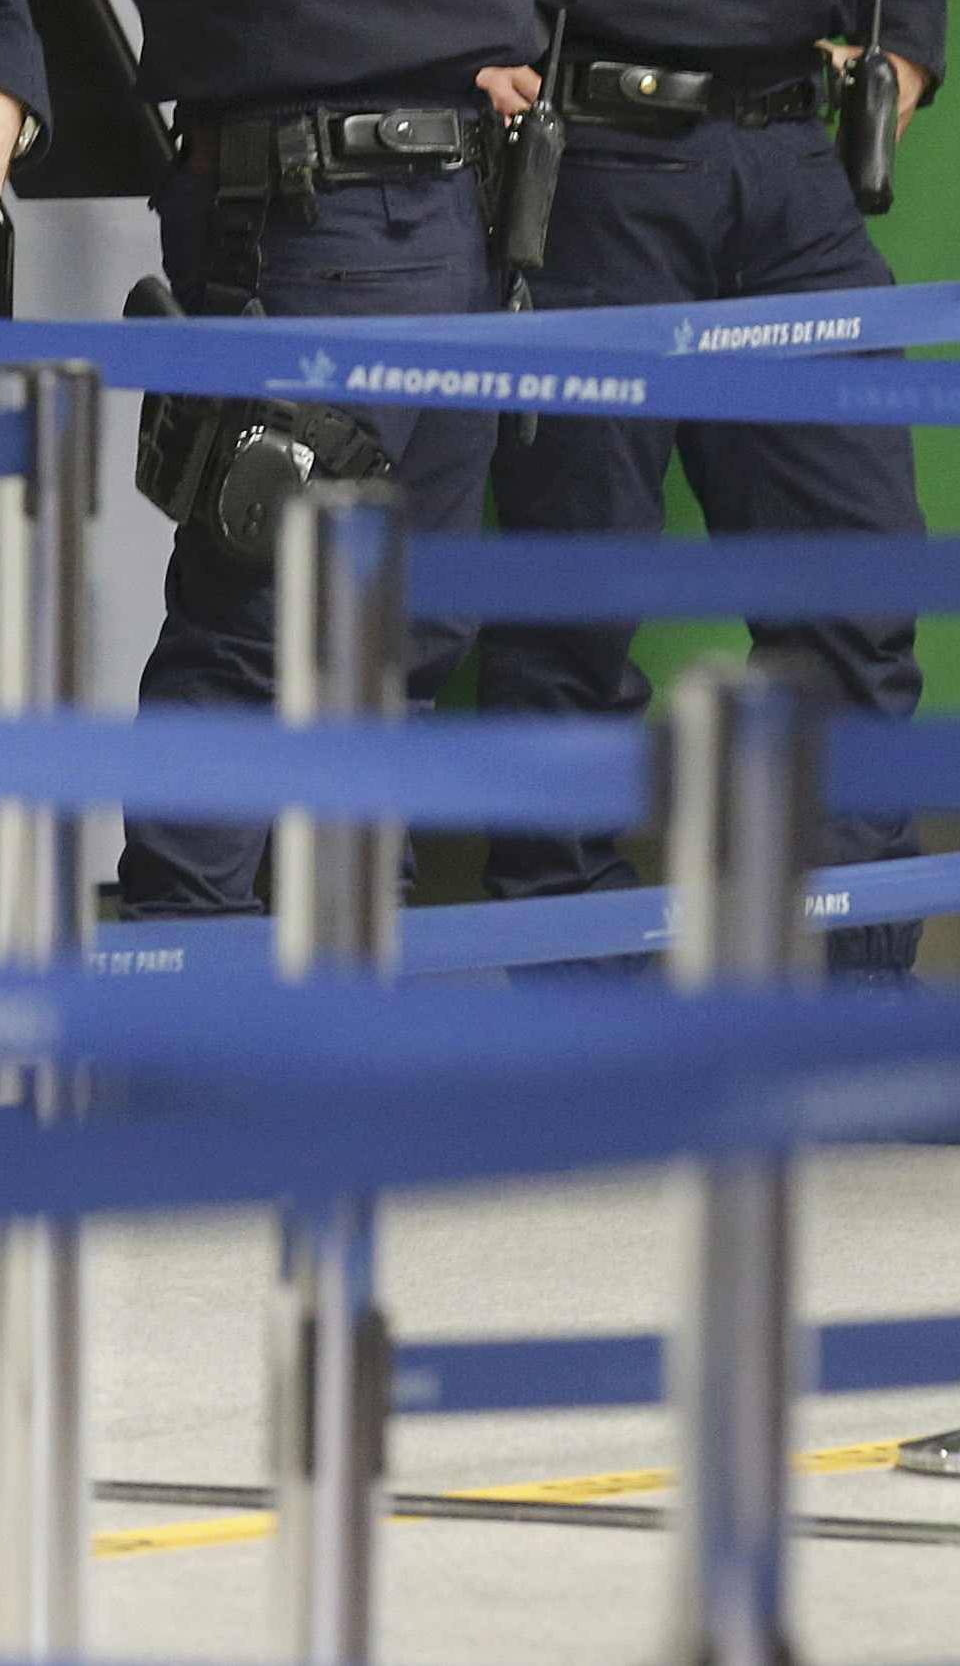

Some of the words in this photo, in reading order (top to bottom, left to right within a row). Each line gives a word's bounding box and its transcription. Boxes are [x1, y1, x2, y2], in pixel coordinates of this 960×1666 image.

[698, 322, 790, 352] AÉROPORTS
[791, 320, 814, 344] DE
[816, 316, 861, 340] PARIS
[346, 362, 512, 399] AÉROPORTS
[517, 373, 558, 401] DE
[562, 377, 646, 405] PARIS
[805, 891, 850, 916] PARIS
[136, 948, 184, 973] PARIS
